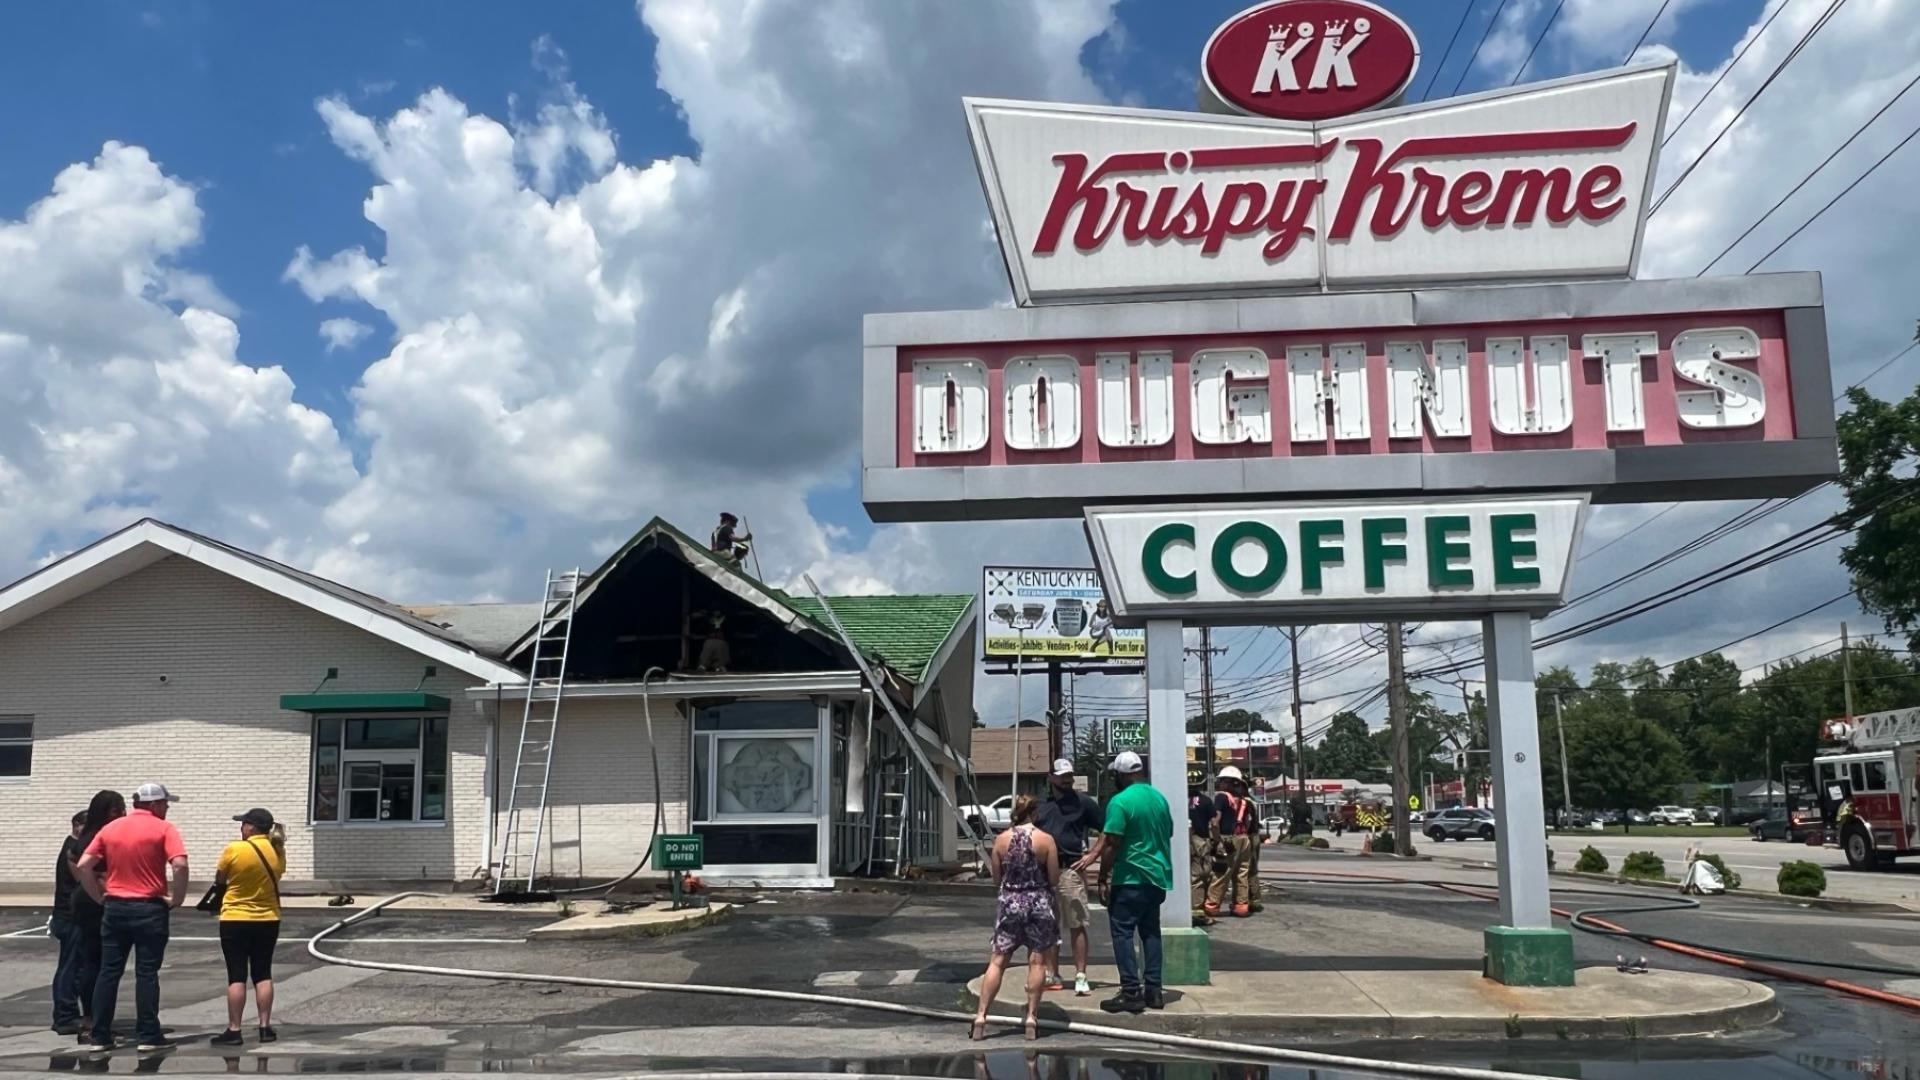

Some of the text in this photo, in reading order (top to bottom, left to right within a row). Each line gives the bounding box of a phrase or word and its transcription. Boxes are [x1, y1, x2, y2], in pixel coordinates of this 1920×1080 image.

[1032, 121, 1637, 259] Krispy Kreme
[912, 326, 1767, 454] DOUGHNUTS
[1141, 513, 1542, 596] COFFEE
[1017, 571, 1083, 587] KENTUCKY
[1074, 641, 1088, 651] Food
[1115, 641, 1127, 652] Fun
[1128, 641, 1139, 652] for
[670, 853, 694, 861] ENTER
